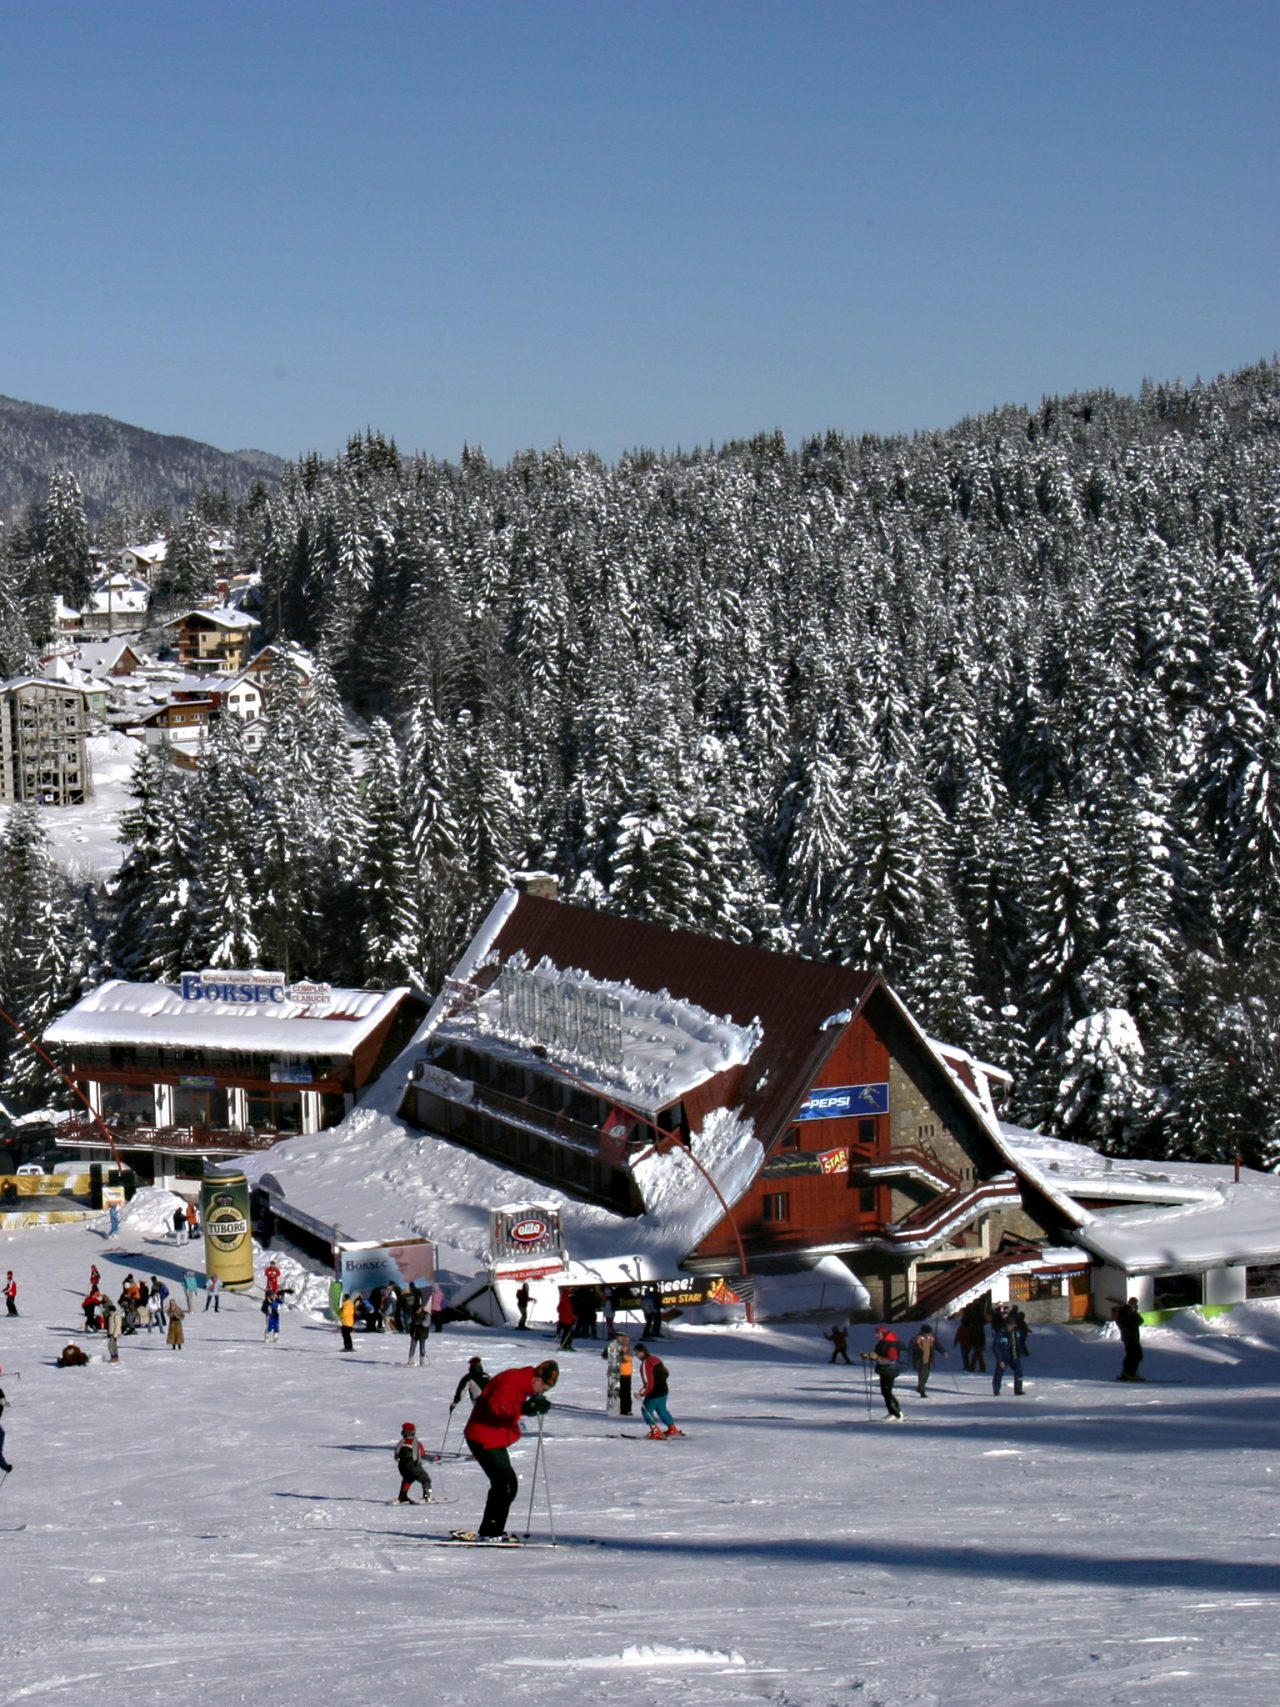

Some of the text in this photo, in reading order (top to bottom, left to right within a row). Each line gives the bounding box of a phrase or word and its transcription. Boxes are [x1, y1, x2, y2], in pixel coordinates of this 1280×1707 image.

[182, 975, 285, 1003] BORSEC
[809, 1096, 851, 1109] PEPSI
[823, 1151, 847, 1174] STAR
[208, 1222, 246, 1234] TUBORG
[518, 1223, 540, 1236] elite
[678, 1293, 702, 1304] STAR!
